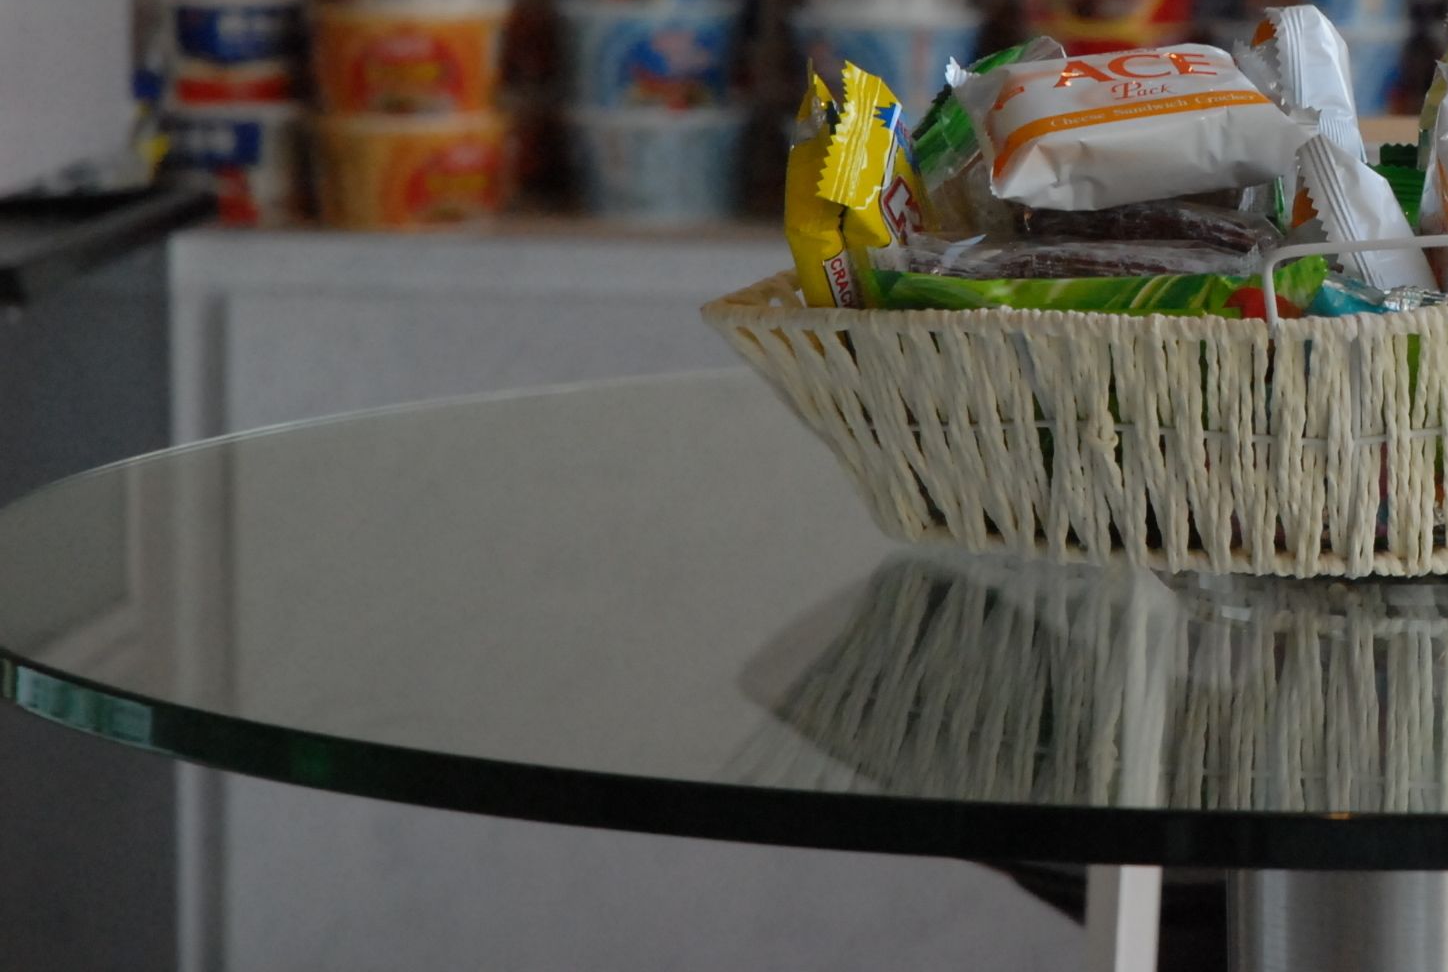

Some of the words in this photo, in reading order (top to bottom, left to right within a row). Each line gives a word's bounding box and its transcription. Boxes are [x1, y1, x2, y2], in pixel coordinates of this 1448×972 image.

[1054, 53, 1217, 88] ACE
[1111, 81, 1178, 101] Pack
[1050, 112, 1106, 127] Cheese
[1113, 98, 1189, 117] Sandwich
[1194, 93, 1257, 105] Cracker
